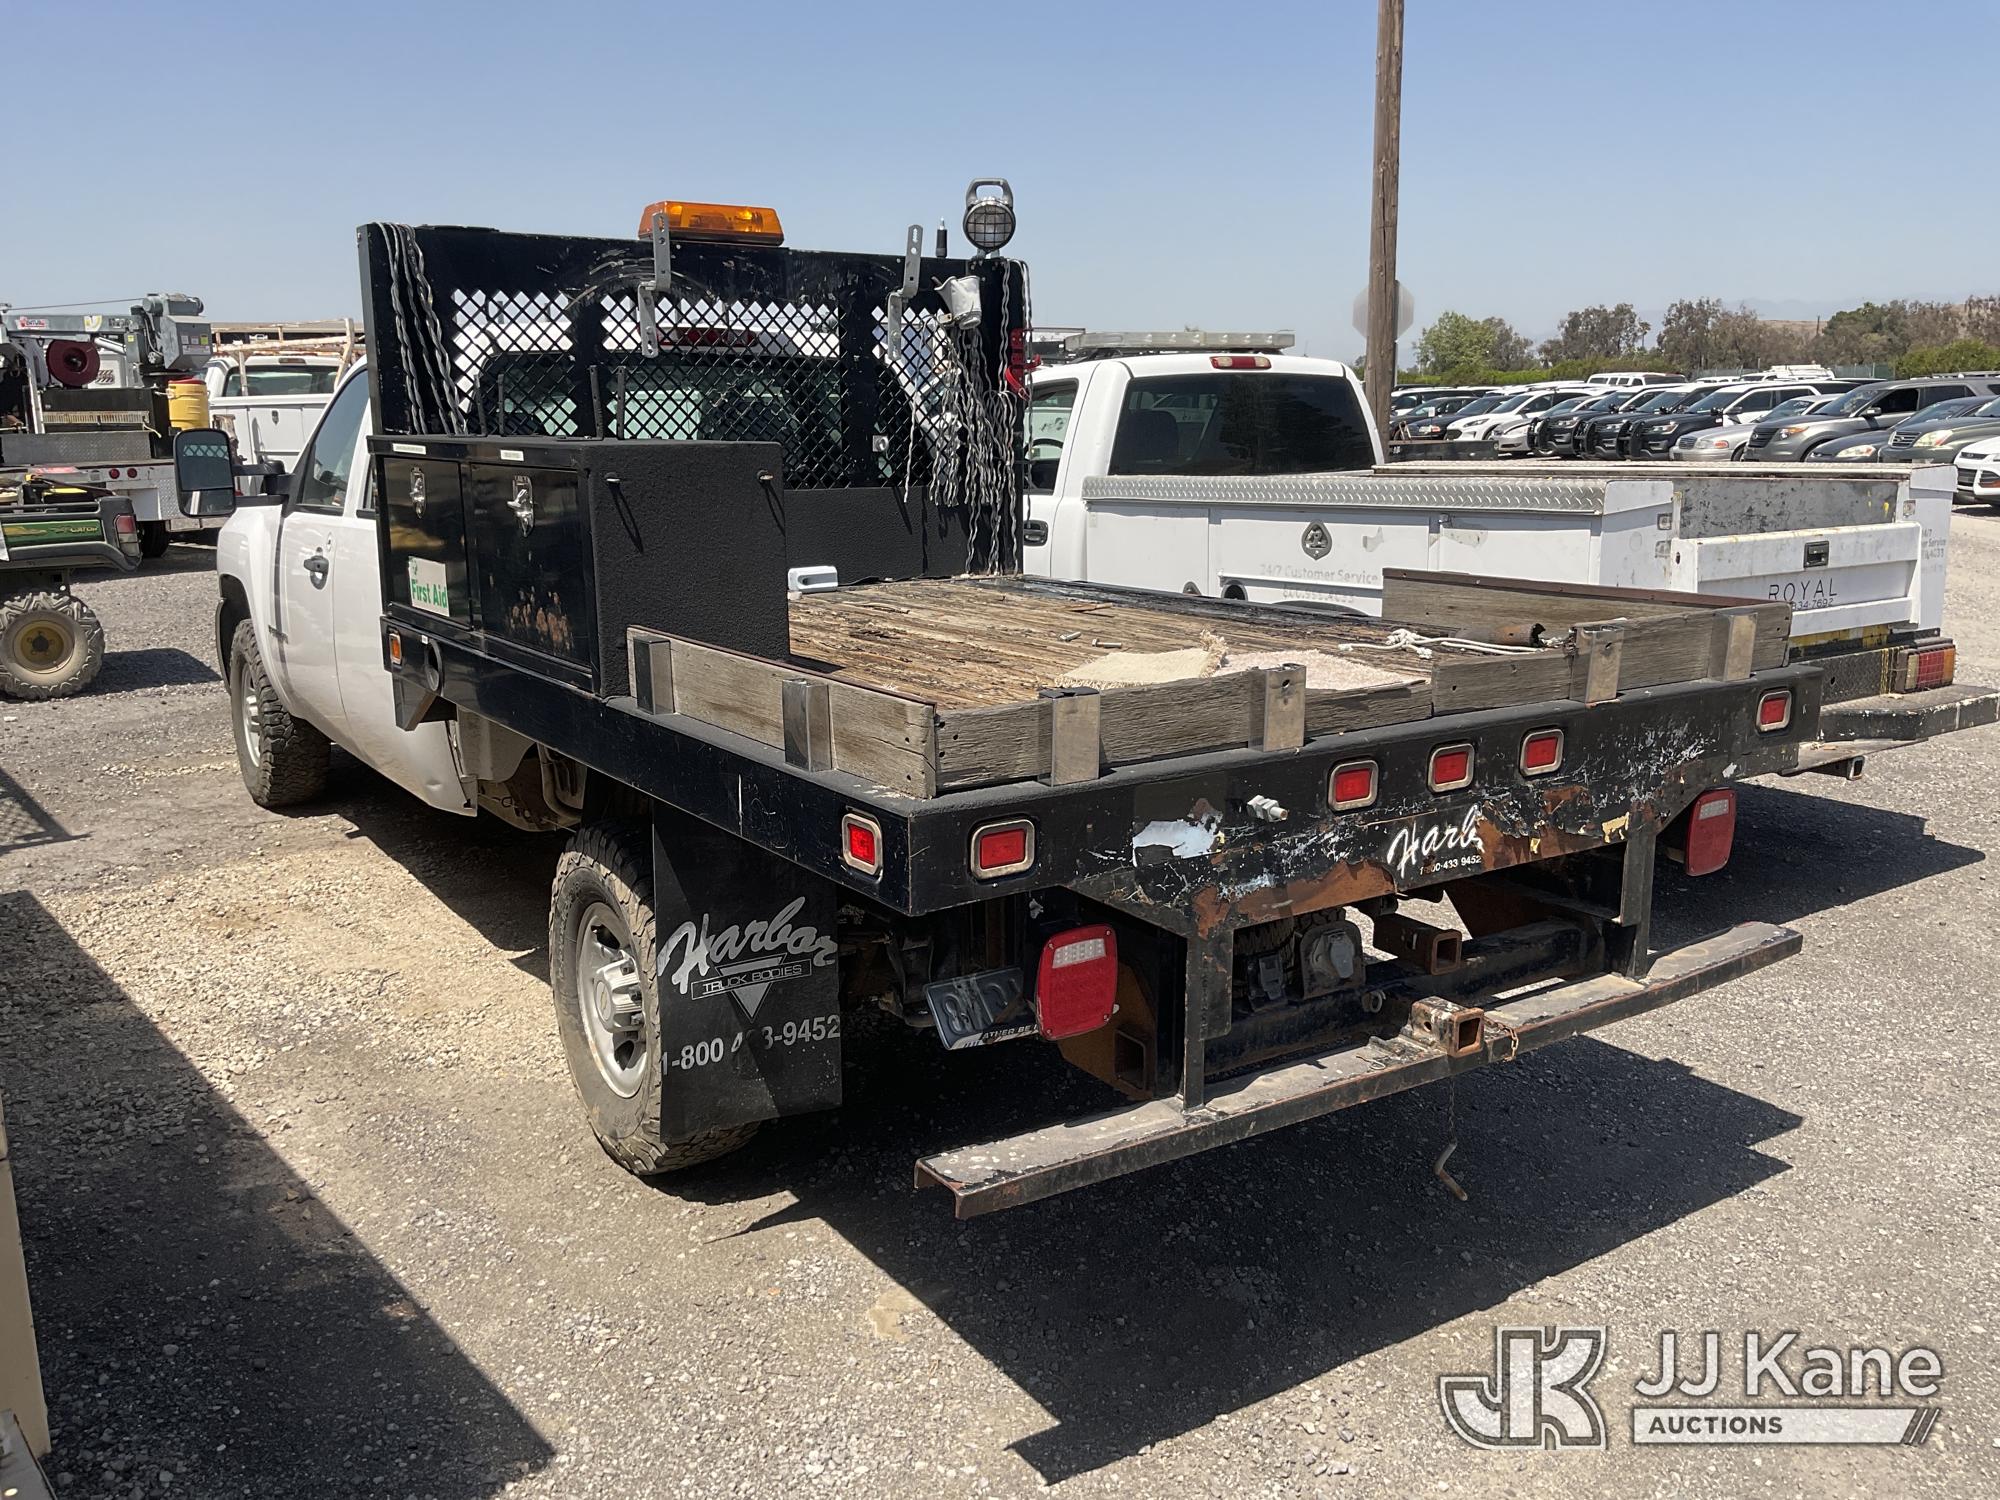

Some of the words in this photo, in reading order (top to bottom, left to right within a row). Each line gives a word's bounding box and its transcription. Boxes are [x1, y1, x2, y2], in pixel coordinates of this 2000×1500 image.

[1284, 565, 1335, 580] Customer
[1337, 569, 1379, 585] Service
[411, 578, 431, 604] First
[432, 583, 448, 608] Aid
[1768, 577, 1838, 602] ROYAL
[1460, 855, 1482, 866] 9452
[703, 974, 747, 995] TRUCK
[752, 964, 802, 982] BODIES
[661, 1037, 724, 1076] 1-800
